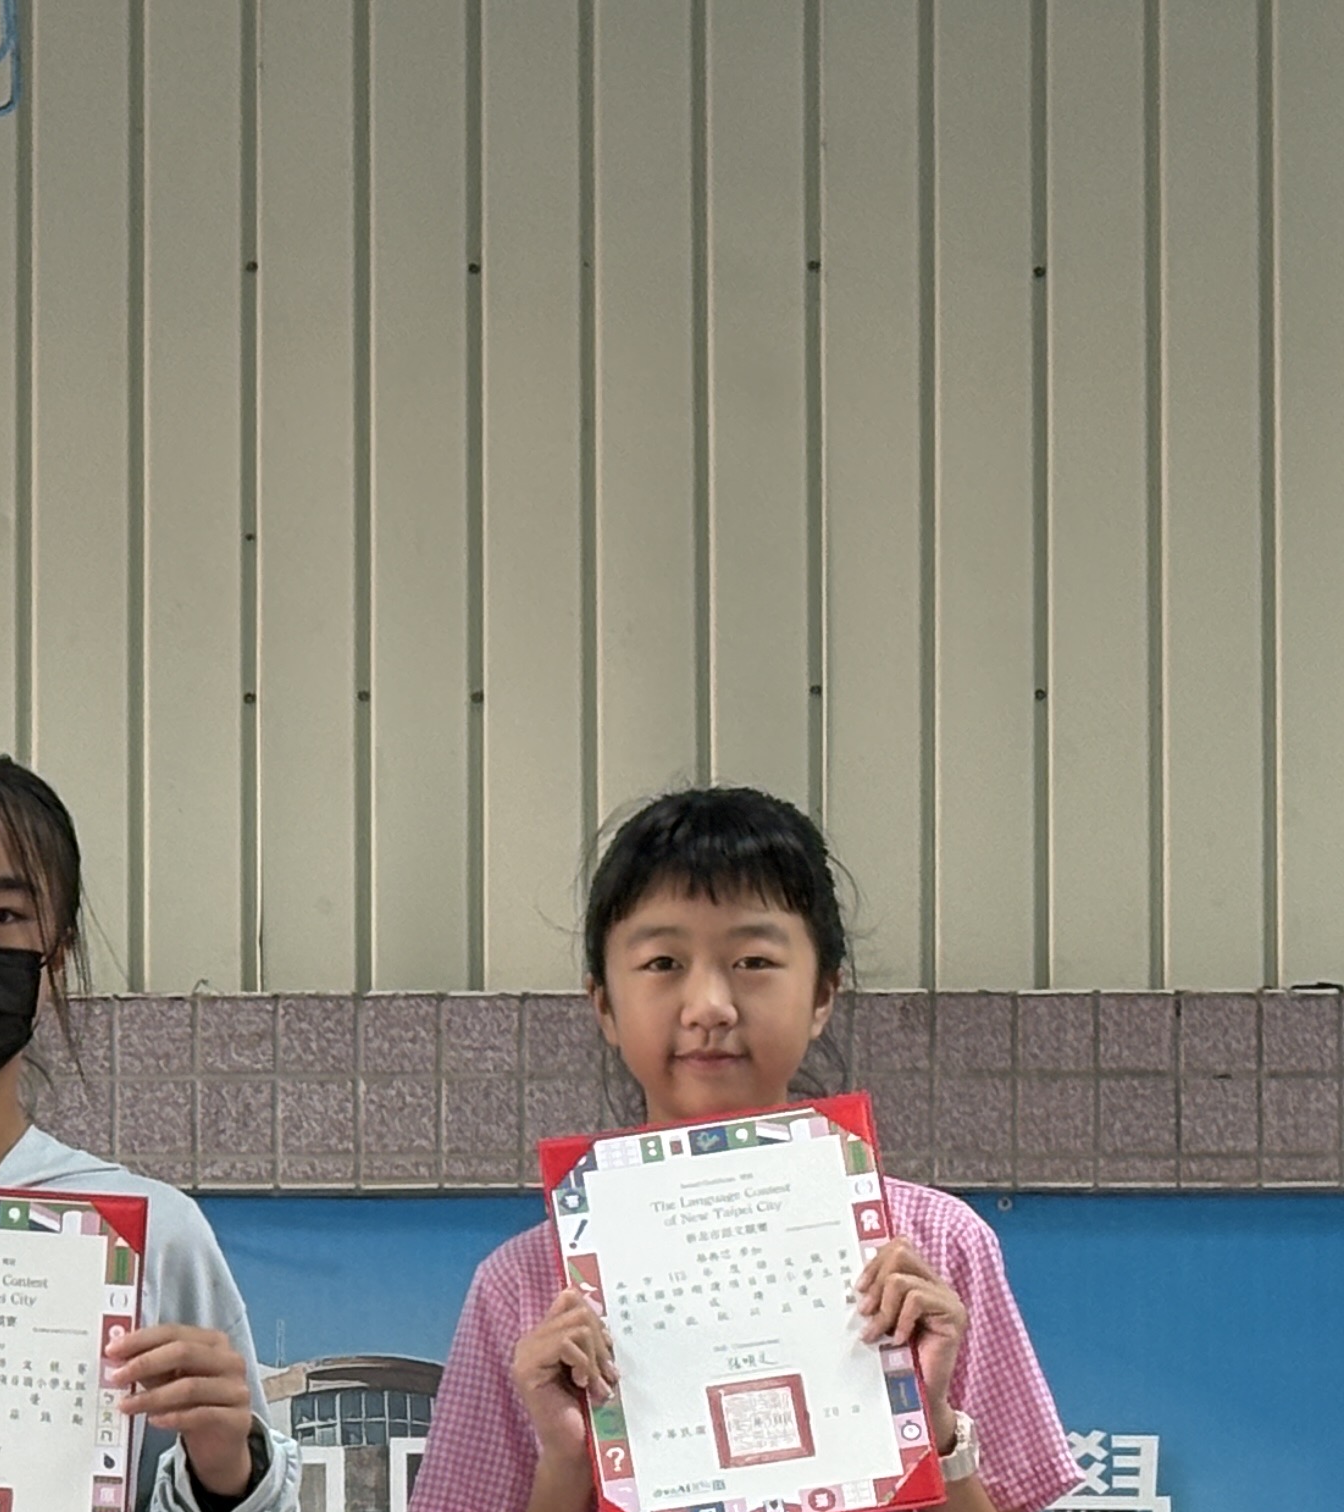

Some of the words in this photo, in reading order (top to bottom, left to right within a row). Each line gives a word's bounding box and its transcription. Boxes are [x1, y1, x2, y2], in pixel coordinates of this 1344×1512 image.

[650, 1201, 676, 1213] The
[680, 1191, 741, 1208] Language
[743, 1183, 791, 1199] Contest
[663, 1213, 677, 1227] of
[680, 1212, 709, 1225] New
[712, 1206, 753, 1221] Taipei
[756, 1200, 783, 1213] City
[2, 1274, 49, 1289] Contest
[10, 1292, 37, 1307] City
